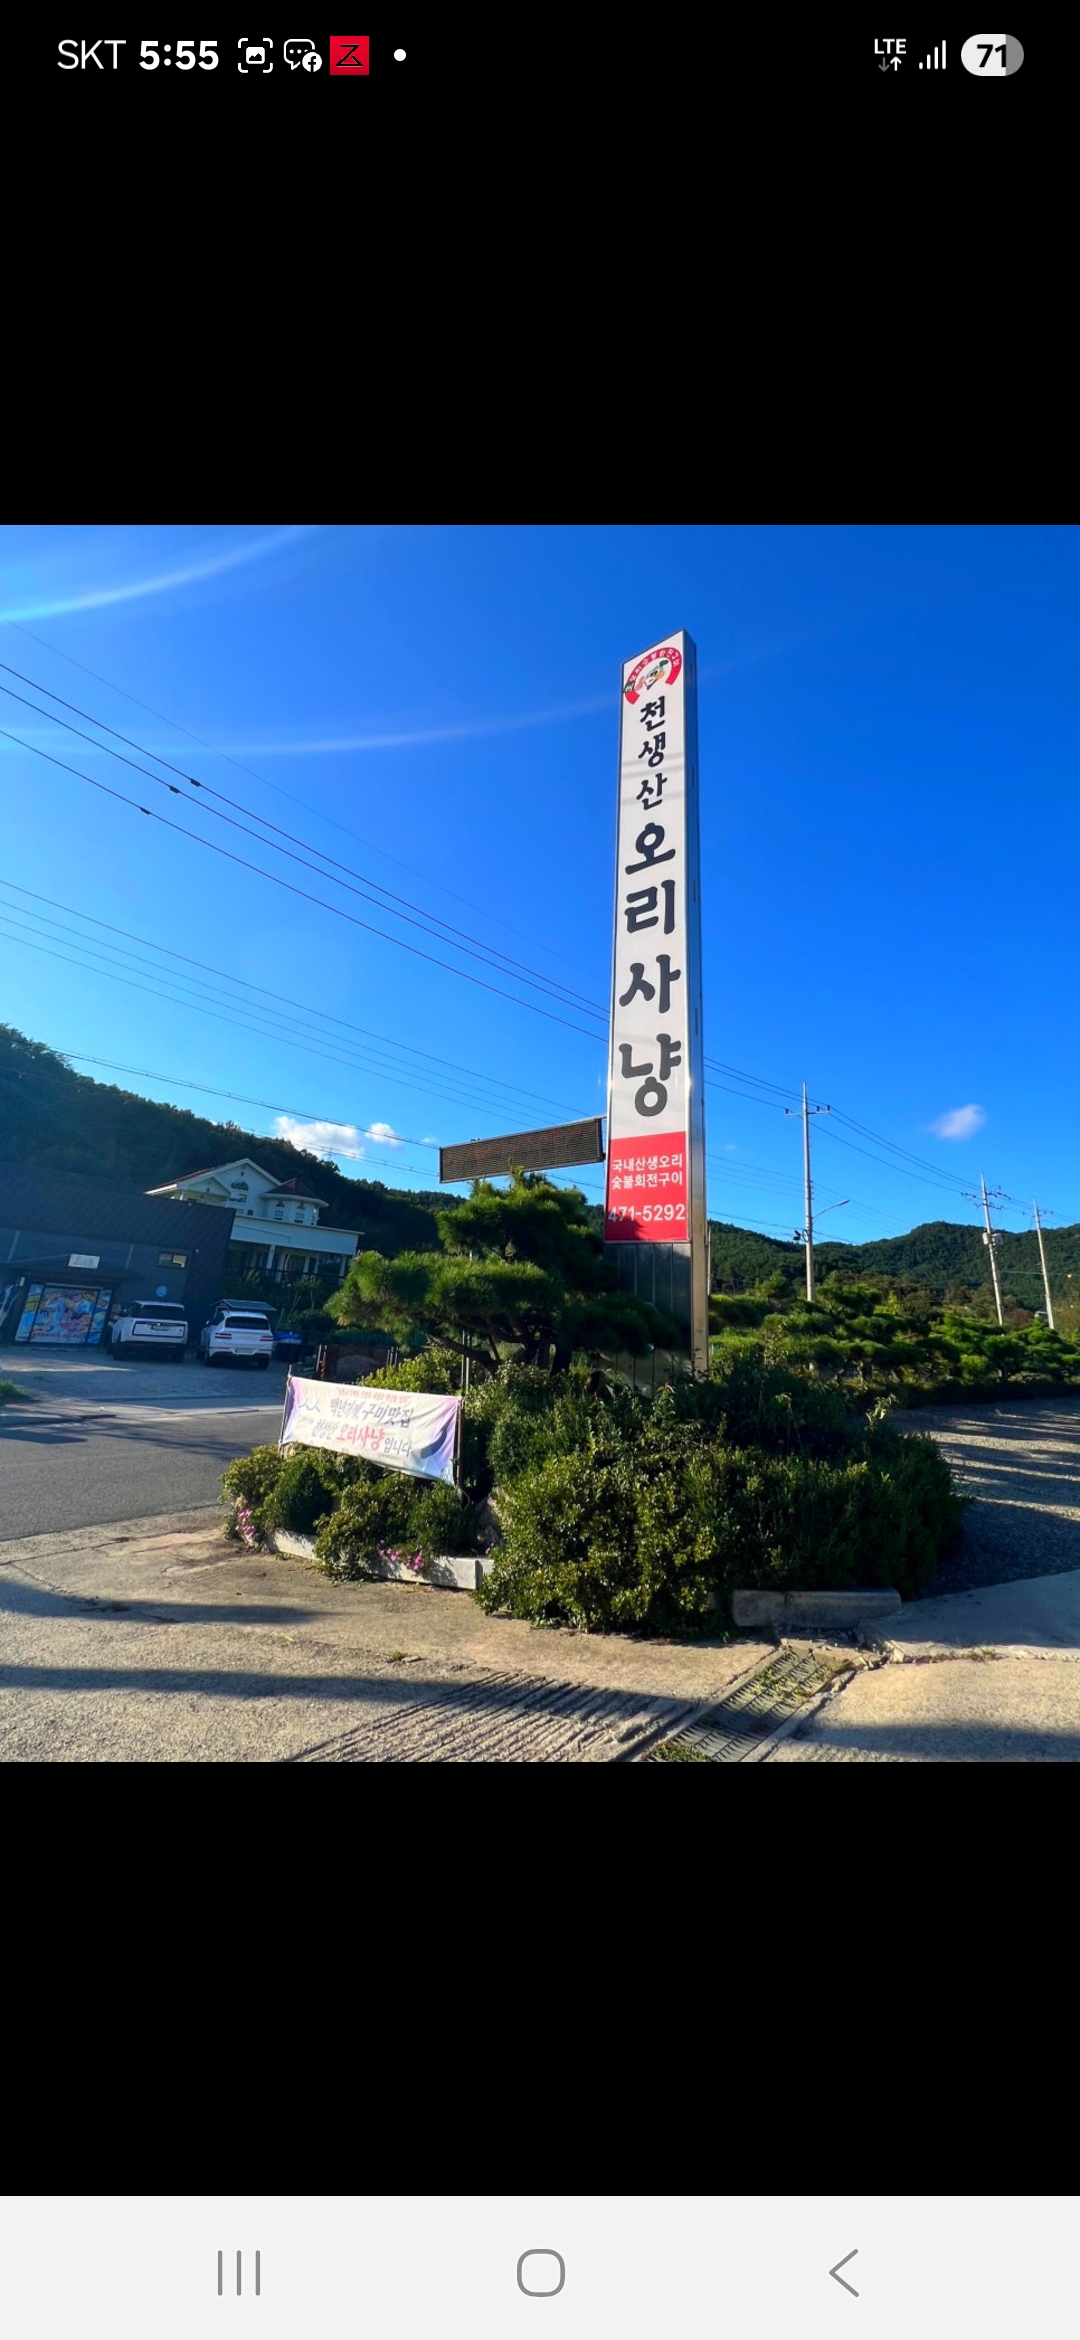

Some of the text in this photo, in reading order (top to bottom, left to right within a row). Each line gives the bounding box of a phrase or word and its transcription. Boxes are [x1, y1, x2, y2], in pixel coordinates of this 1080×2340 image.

[620, 696, 682, 1117] 천생산 오리사냥
[608, 1203, 686, 1223] 471-5292
[362, 1402, 415, 1429] 구미맛집
